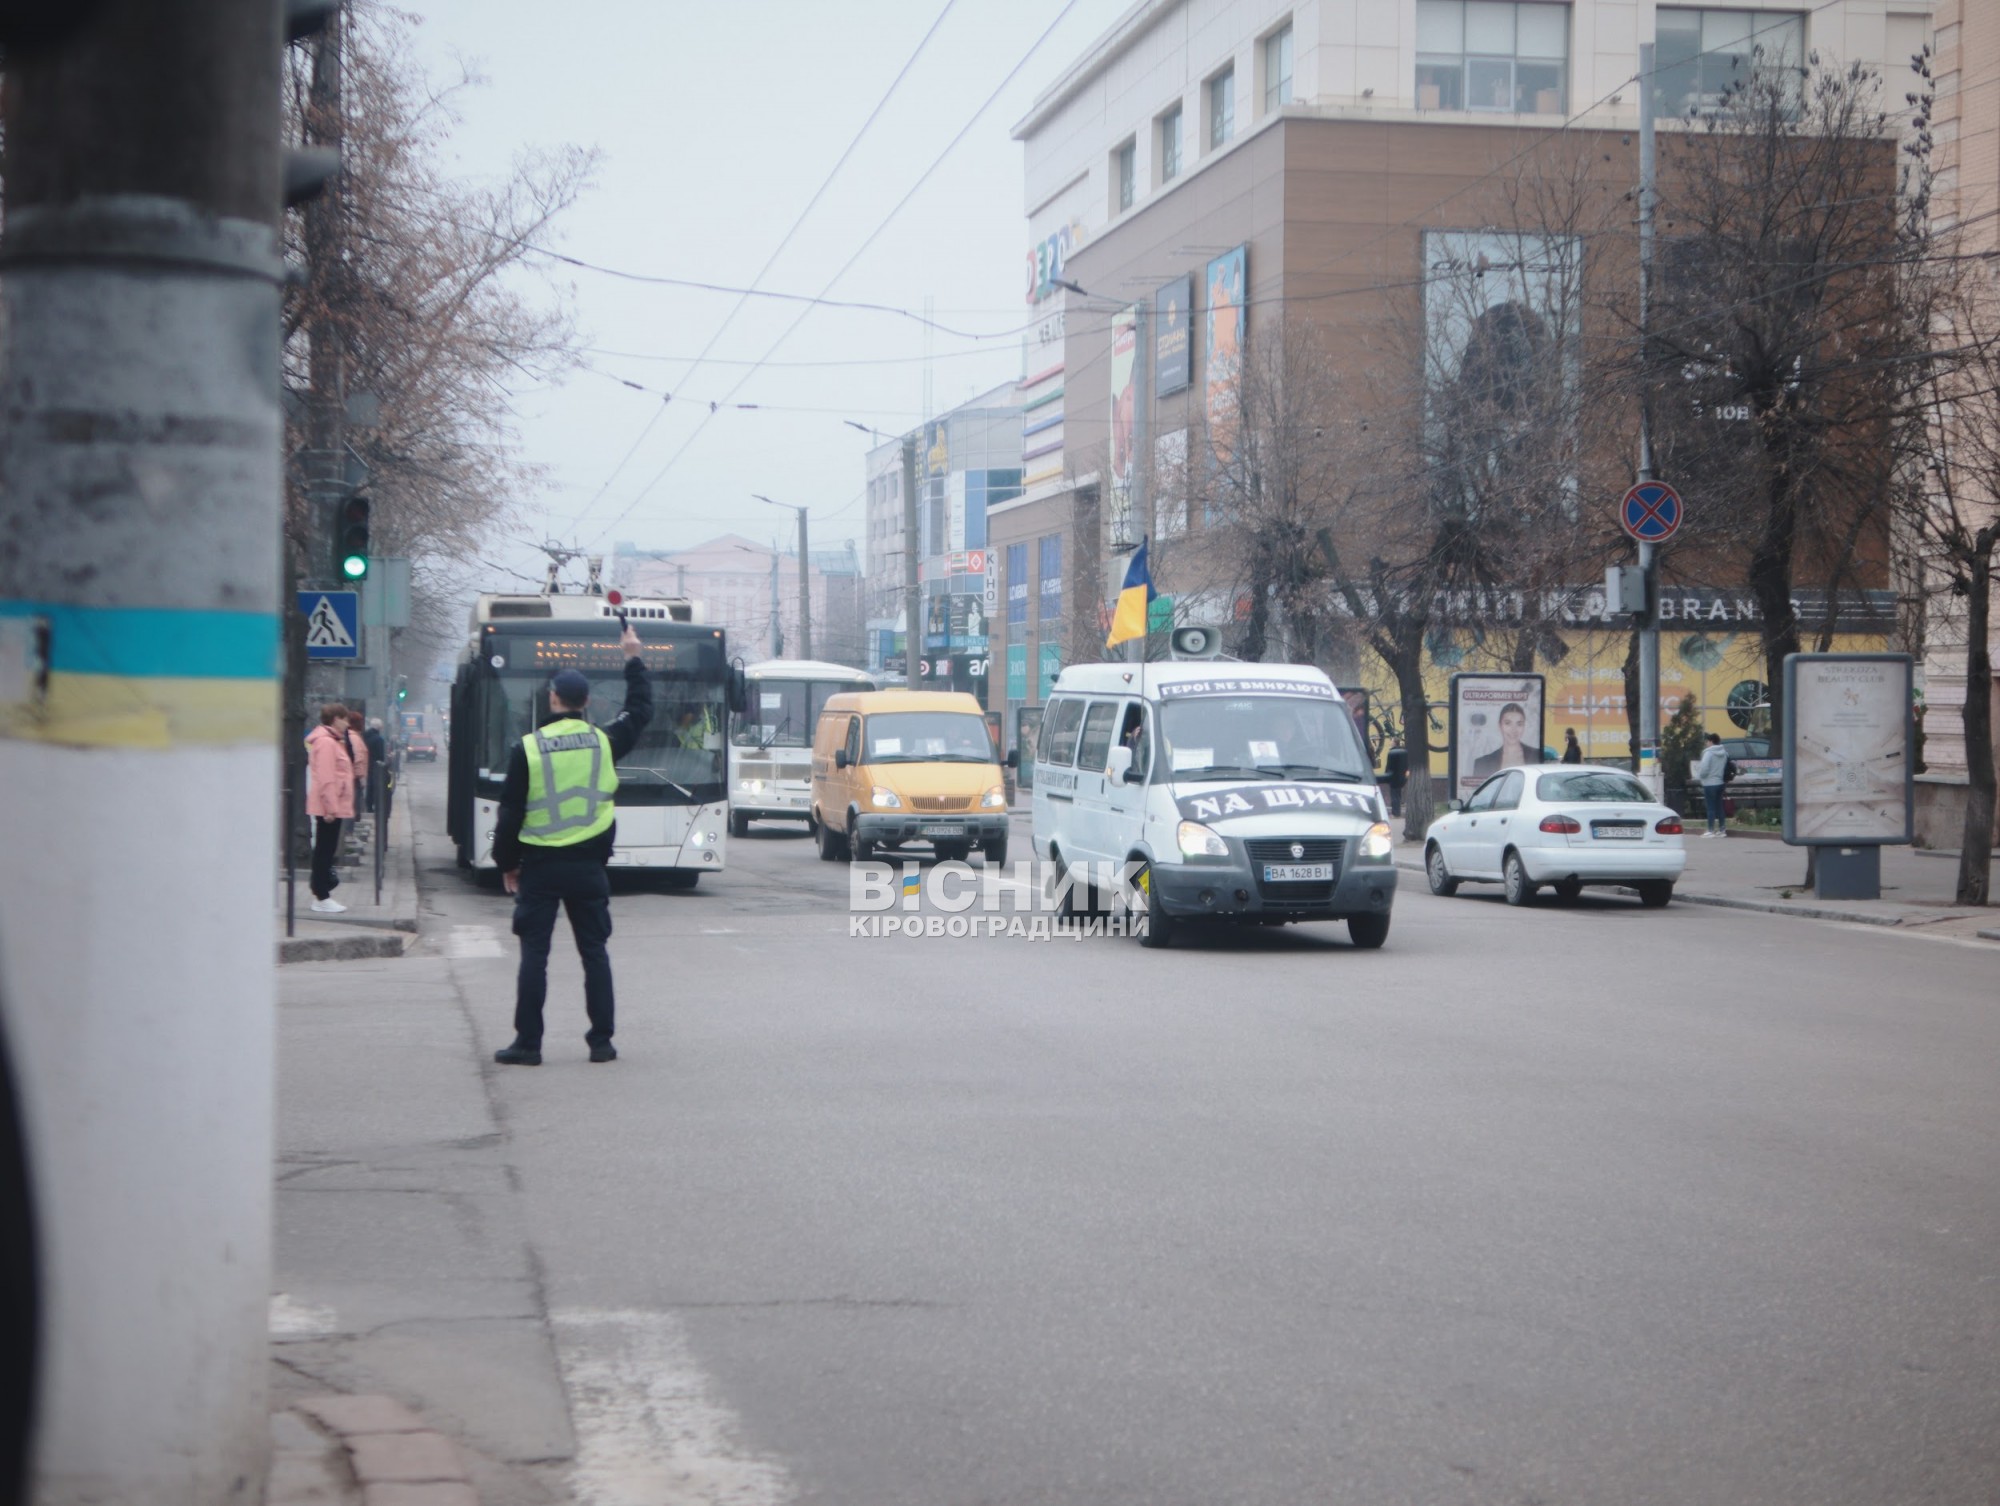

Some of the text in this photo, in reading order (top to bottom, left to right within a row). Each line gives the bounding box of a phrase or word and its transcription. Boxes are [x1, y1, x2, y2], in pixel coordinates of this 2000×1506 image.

[986, 554, 995, 601] КІНО
[1659, 598, 1801, 621] BRANS
[1161, 682, 1211, 695] ГЕРОЇ
[1240, 680, 1332, 695] ВМИРАЮТЬ
[1817, 675, 1885, 683] BEAUTY CLUB
[1568, 695, 1681, 717] ЦИТС
[1261, 788, 1372, 814] ЩИТІ
[1271, 868, 1286, 879] BA
[1290, 868, 1312, 878] 1628
